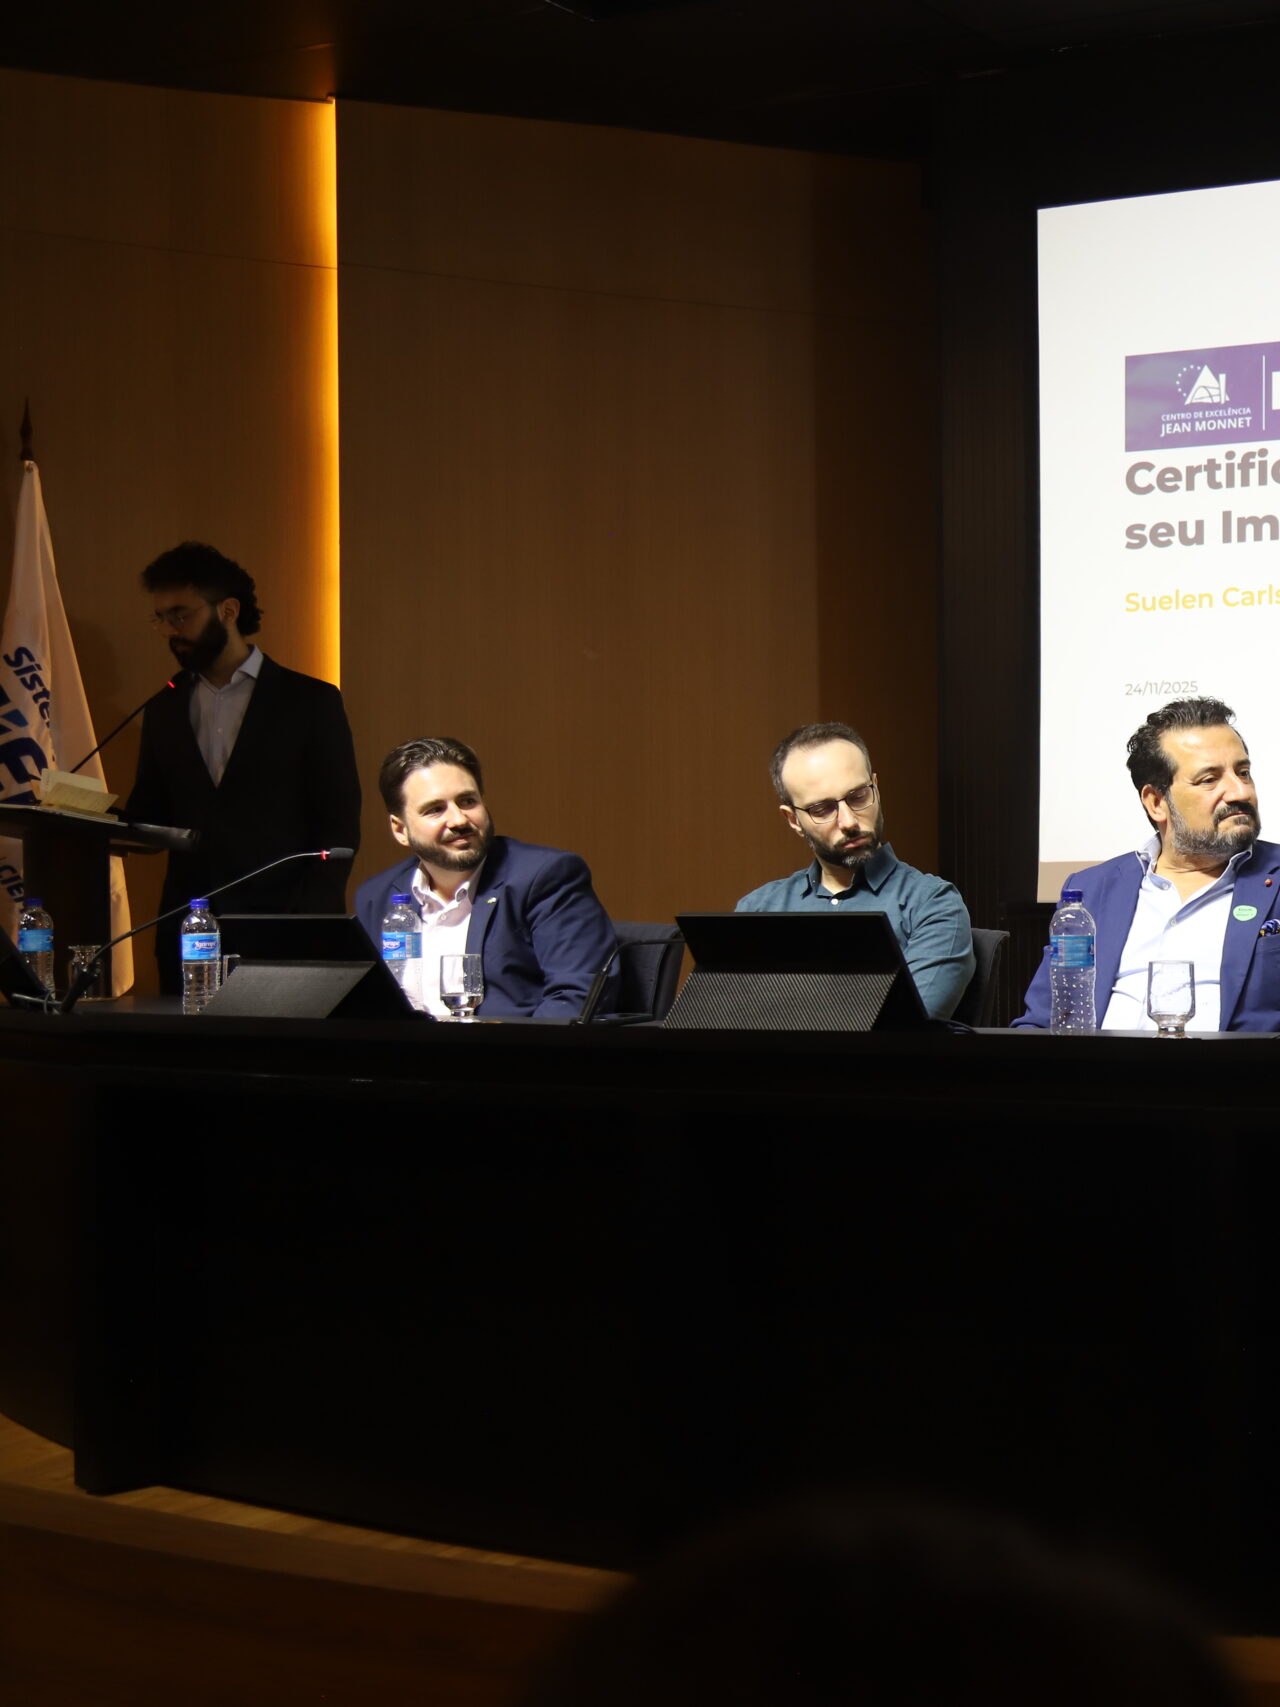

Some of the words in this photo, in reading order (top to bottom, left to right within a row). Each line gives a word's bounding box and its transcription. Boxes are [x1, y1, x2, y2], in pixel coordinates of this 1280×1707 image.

[1161, 413, 1192, 422] CENTRO
[1193, 411, 1203, 419] DE
[1205, 407, 1252, 418] EXCELÊNCIA
[1160, 422, 1192, 437] JEAN
[1195, 417, 1252, 432] MONNET
[1125, 519, 1204, 550] seu
[1125, 589, 1213, 613] Suelen
[3, 646, 50, 729] Siste
[1125, 680, 1199, 696] 24/11/2025
